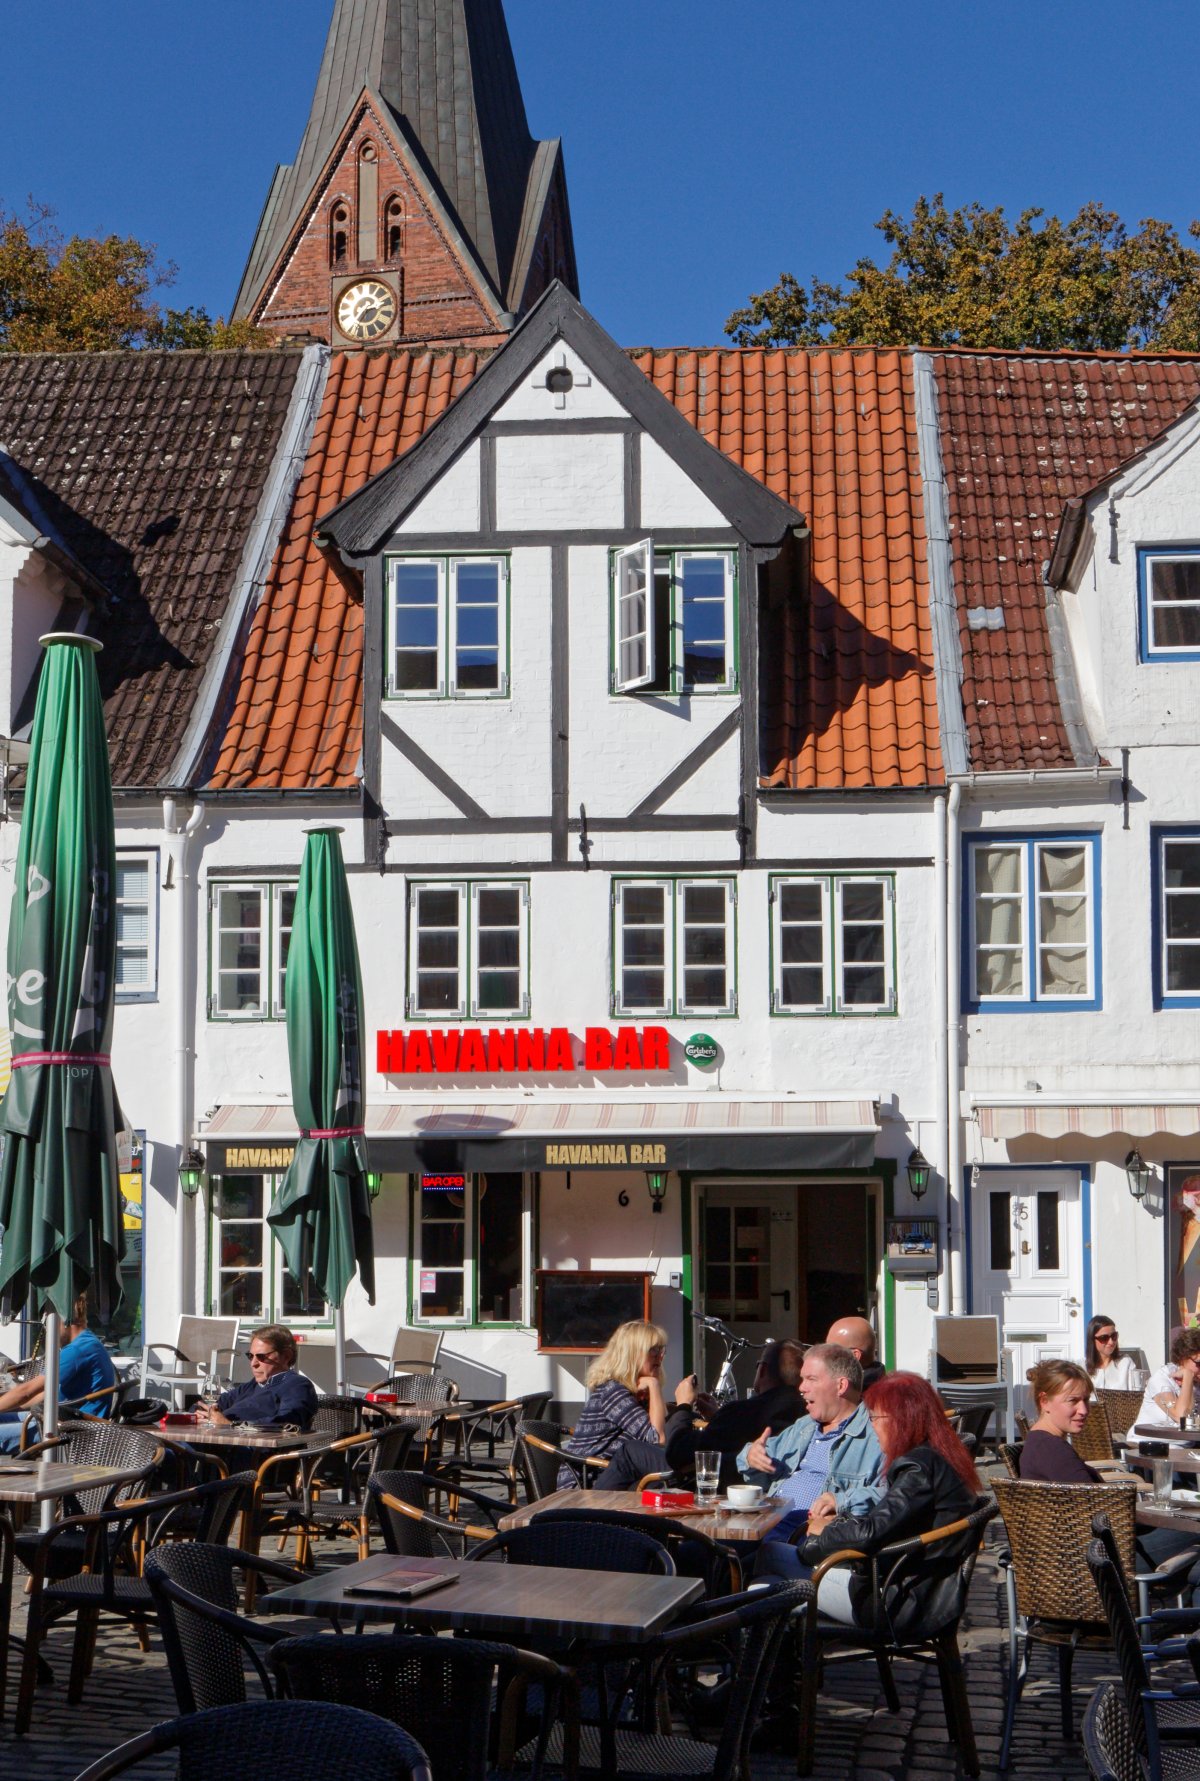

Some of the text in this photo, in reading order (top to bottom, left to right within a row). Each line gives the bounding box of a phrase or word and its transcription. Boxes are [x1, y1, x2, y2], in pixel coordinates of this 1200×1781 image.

[377, 1026, 670, 1073] HAVANNA BAR
[685, 1045, 717, 1056] Carlsberg
[226, 1148, 295, 1167] HAVANN
[546, 1144, 666, 1164] HAVANNA BAR
[423, 1176, 443, 1187] BAR
[618, 1189, 630, 1207] 6
[1020, 1206, 1029, 1220] 5
